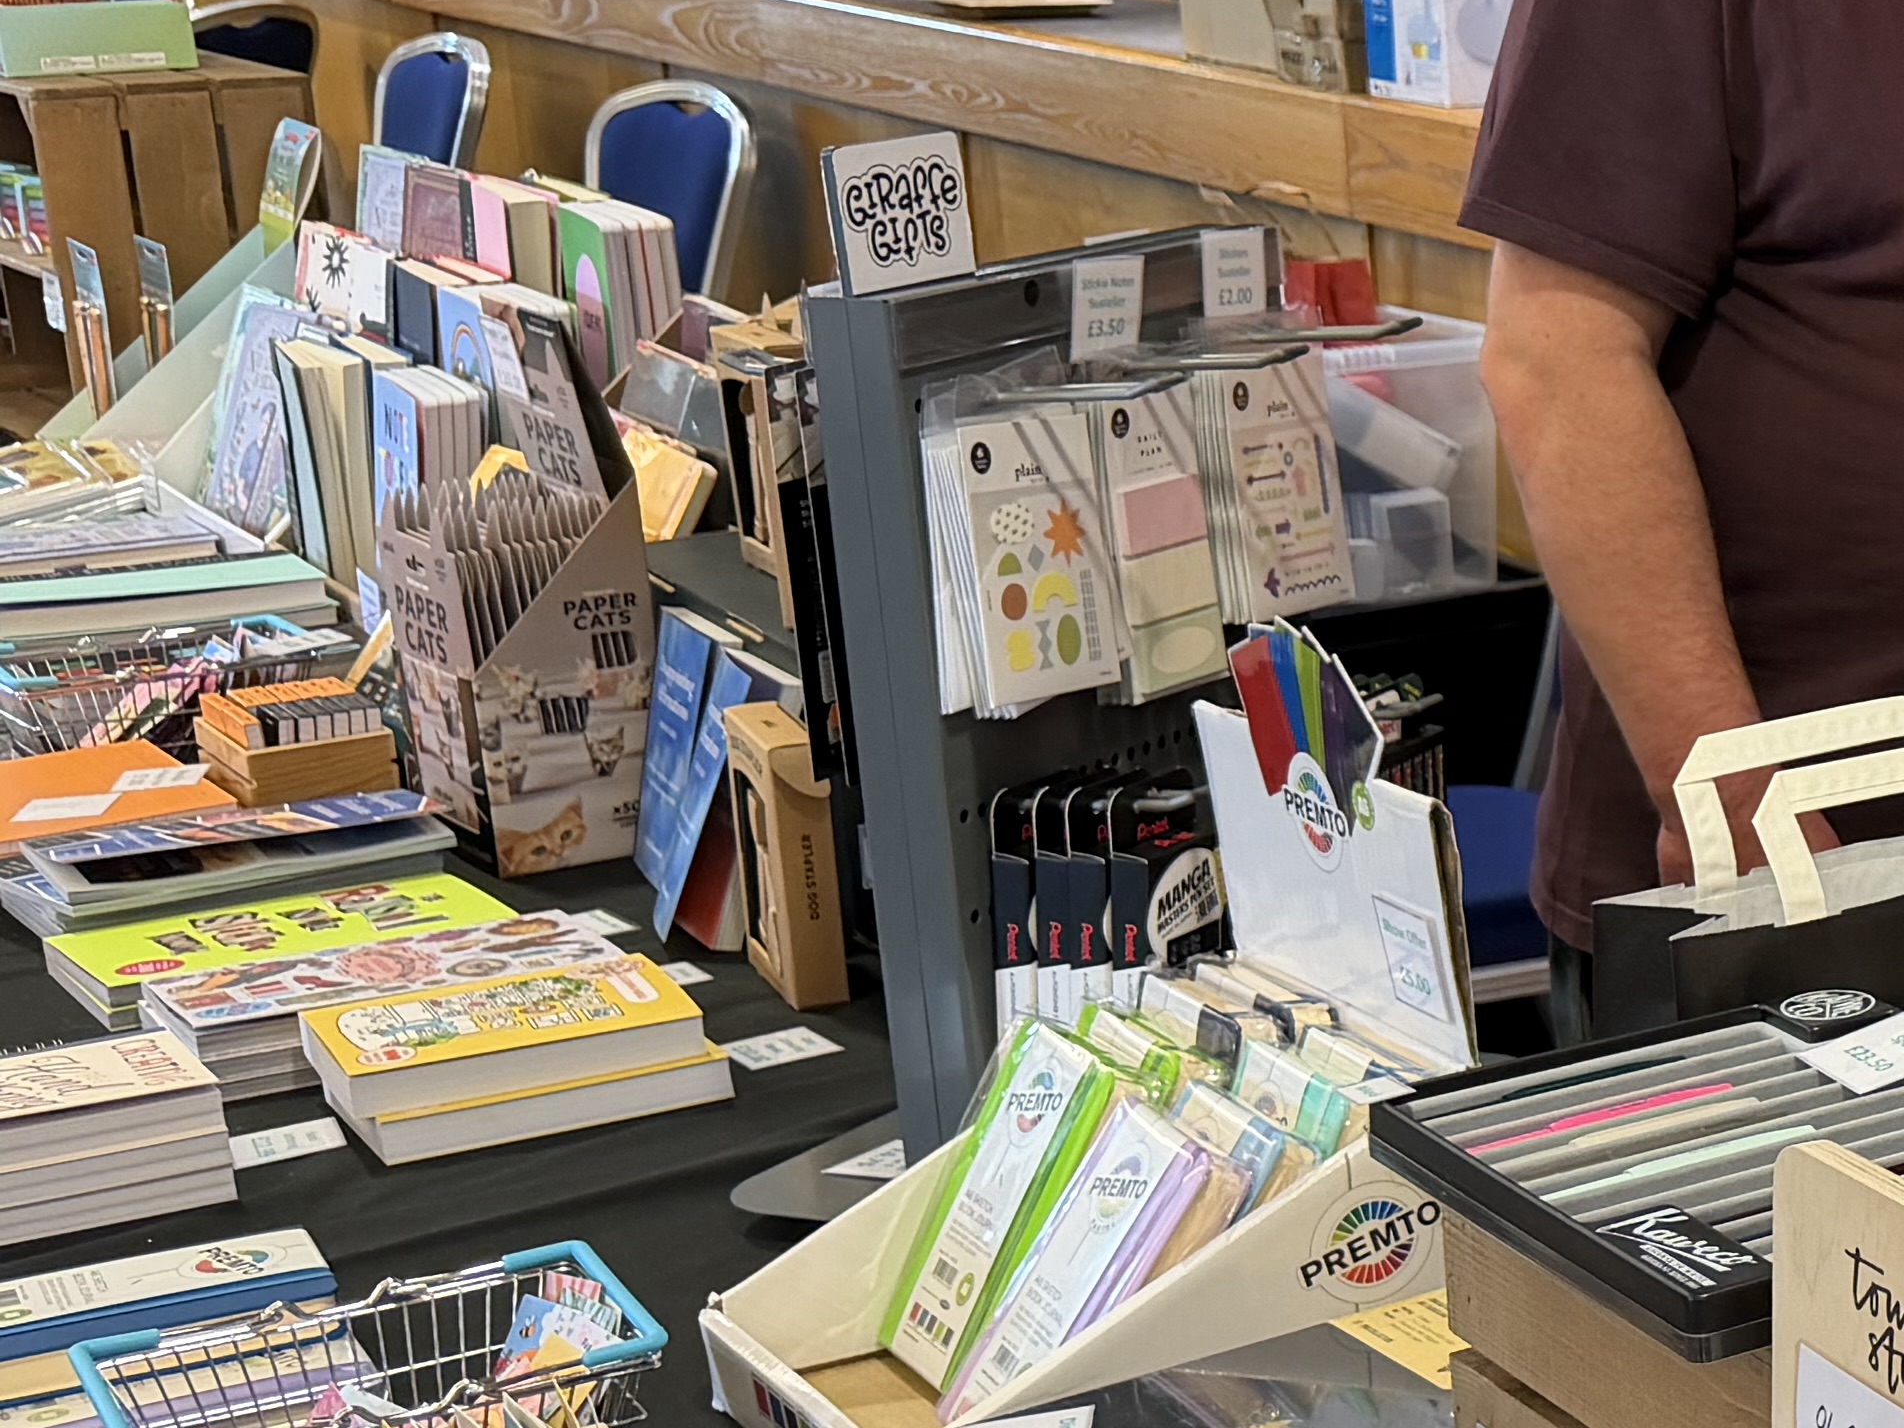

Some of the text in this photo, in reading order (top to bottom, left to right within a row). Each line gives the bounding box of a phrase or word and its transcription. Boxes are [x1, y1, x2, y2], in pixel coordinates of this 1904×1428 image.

[1218, 287, 1252, 306] £2.00
[1088, 318, 1125, 338] £3.50
[524, 412, 579, 457] PAPER
[538, 445, 581, 488] CATS
[395, 585, 448, 633] PAPER
[564, 591, 637, 617] PAPER
[573, 611, 631, 632] CATS
[405, 624, 448, 665] CATS
[1284, 788, 1347, 838] PREMTO
[801, 834, 820, 921] DOG STAPLER
[1158, 858, 1211, 920] MANGA
[1844, 1044, 1894, 1072] £23.50
[1008, 1092, 1063, 1112] PREMTO
[1090, 1177, 1148, 1200] PREMTO
[1298, 1196, 1441, 1289] PREMTO
[1612, 1206, 1757, 1270] Kaweco
